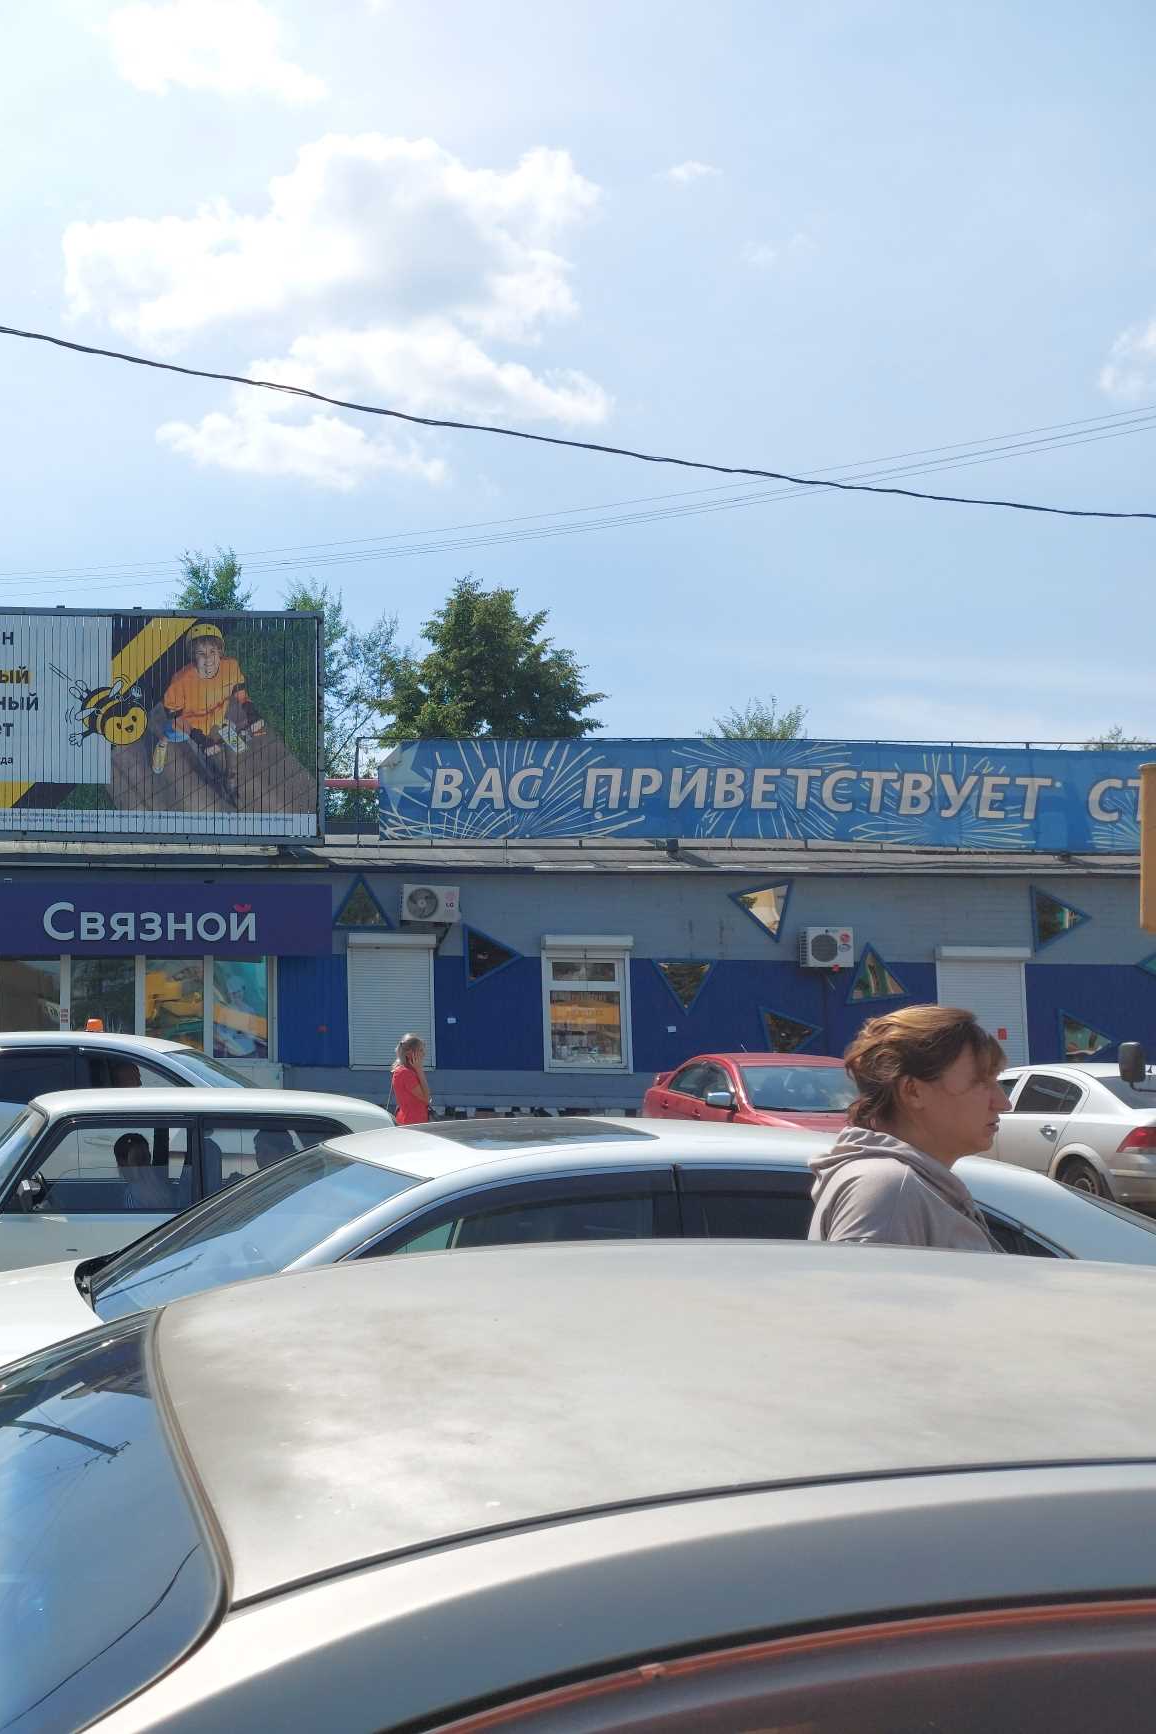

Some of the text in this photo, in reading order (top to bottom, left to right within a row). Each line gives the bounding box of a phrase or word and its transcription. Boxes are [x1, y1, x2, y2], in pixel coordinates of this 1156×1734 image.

[430, 767, 544, 810] ВАС
[582, 766, 1053, 822] ПРИВЕТСТВУЕТ
[43, 901, 257, 942] Связной
